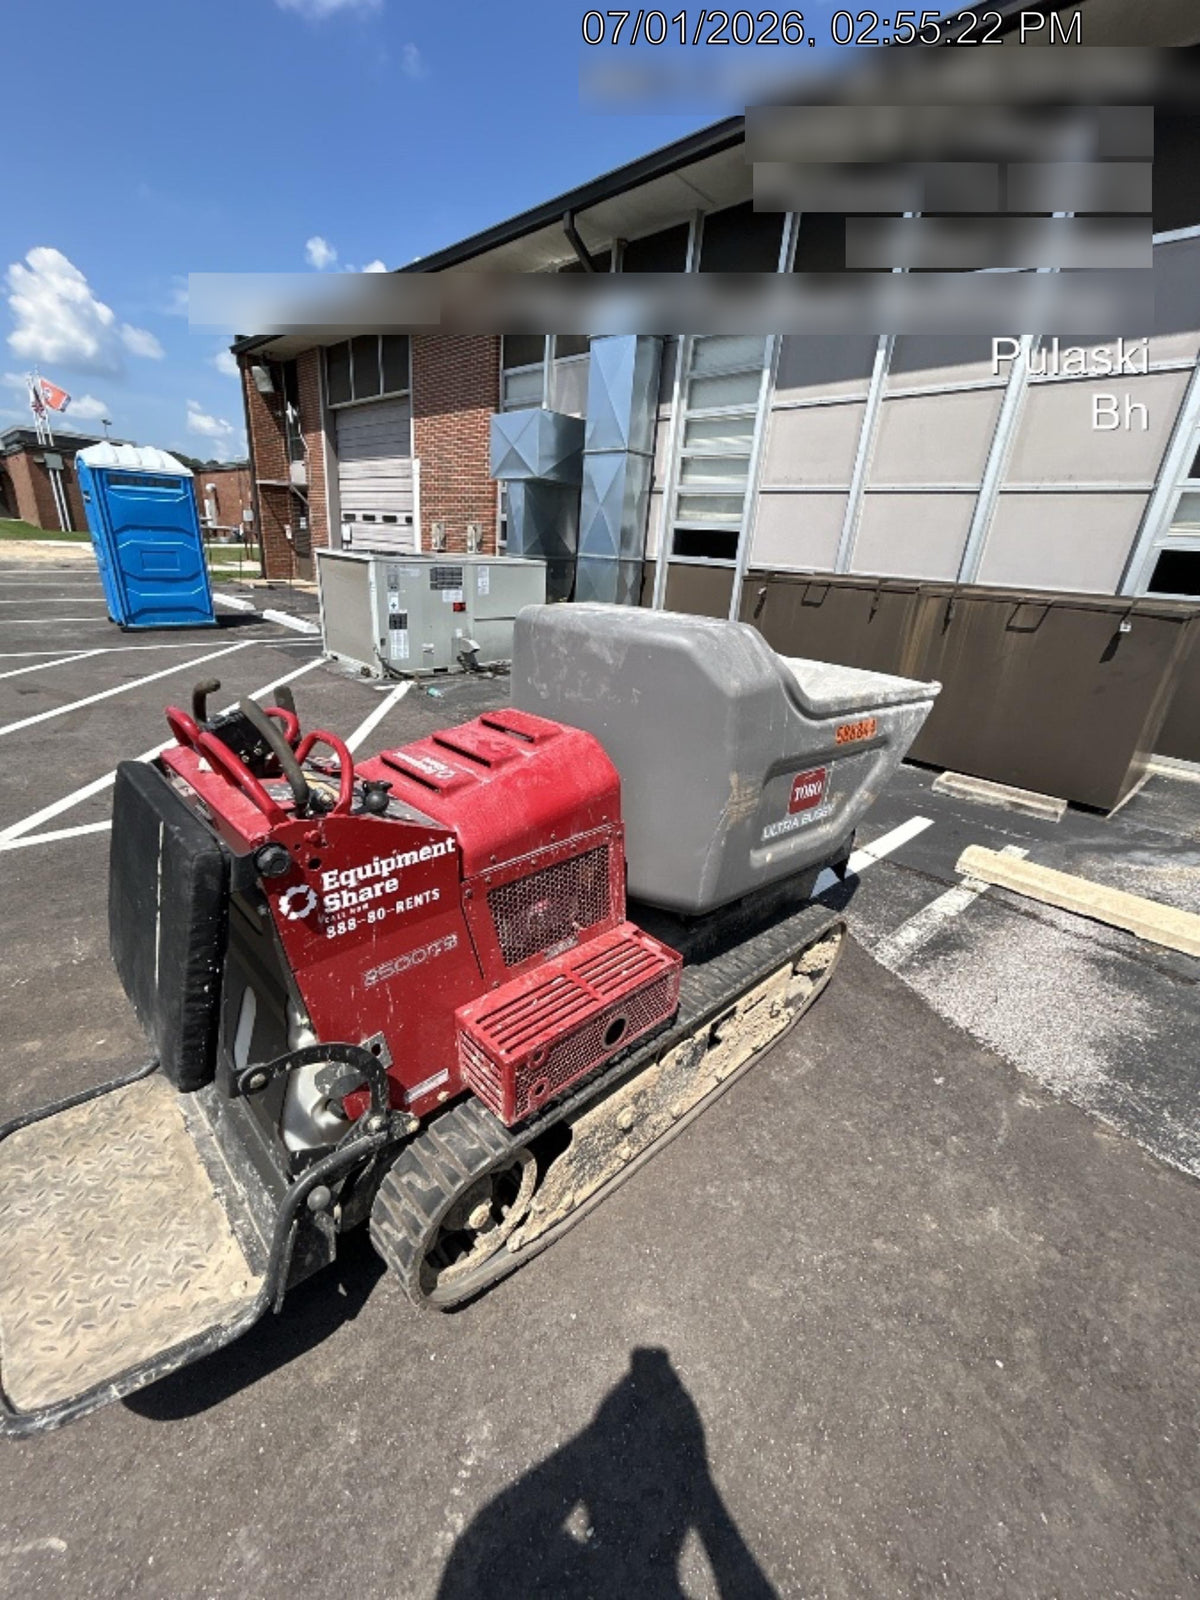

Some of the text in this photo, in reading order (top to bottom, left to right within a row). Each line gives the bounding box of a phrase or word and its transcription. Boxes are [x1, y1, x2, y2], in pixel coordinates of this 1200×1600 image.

[793, 781, 823, 803] TORO
[762, 817, 799, 839] ULTRA
[321, 837, 456, 892] Equipment
[322, 877, 399, 913] Share
[324, 911, 346, 924] CALL
